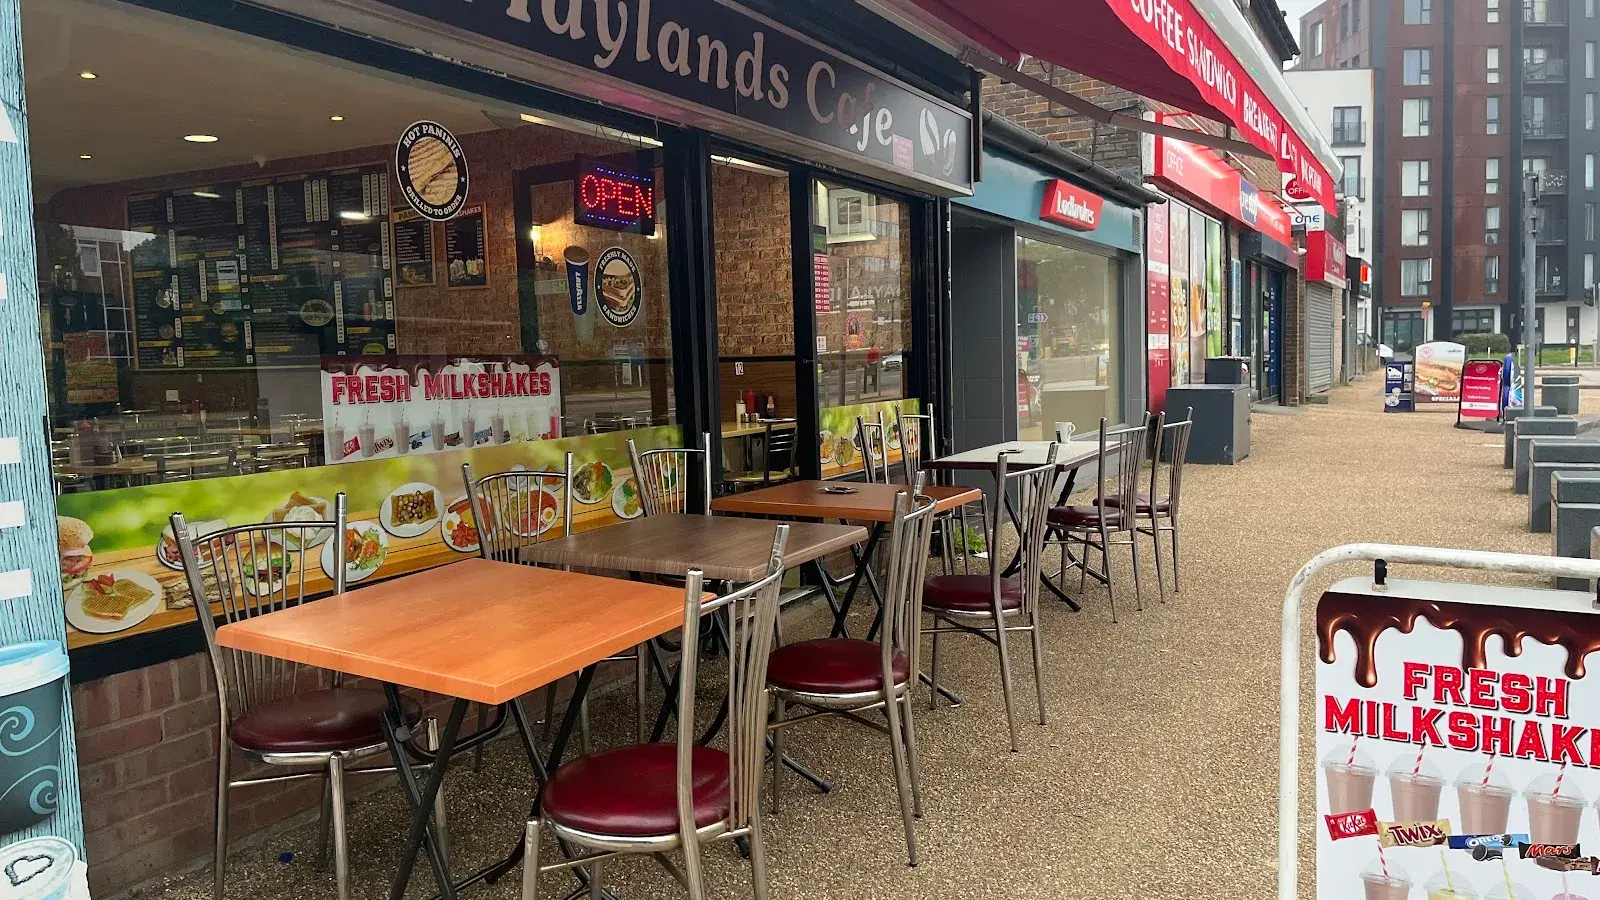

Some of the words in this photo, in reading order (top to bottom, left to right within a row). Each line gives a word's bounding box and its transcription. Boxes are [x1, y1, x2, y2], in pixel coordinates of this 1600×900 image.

[464, 0, 790, 110] aylands
[806, 61, 894, 152] Cafe
[402, 127, 423, 148] HOT
[421, 124, 461, 158] PANINIS
[406, 186, 433, 215] GRILLED
[433, 207, 444, 216] TO
[444, 194, 463, 215] ORDER
[582, 173, 653, 220] OPEN
[1288, 187, 1308, 195] OFFI
[1056, 190, 1096, 225] Ladbrokes
[599, 250, 621, 271] FRESHLY
[621, 252, 637, 273] MADE
[602, 303, 638, 324] SANDWICHES
[331, 374, 412, 405] FRESH
[424, 371, 552, 400] MILKSHAKES
[1402, 661, 1571, 719] FRESH
[1467, 835, 1500, 848] OREO
[1524, 843, 1574, 858] Mars
